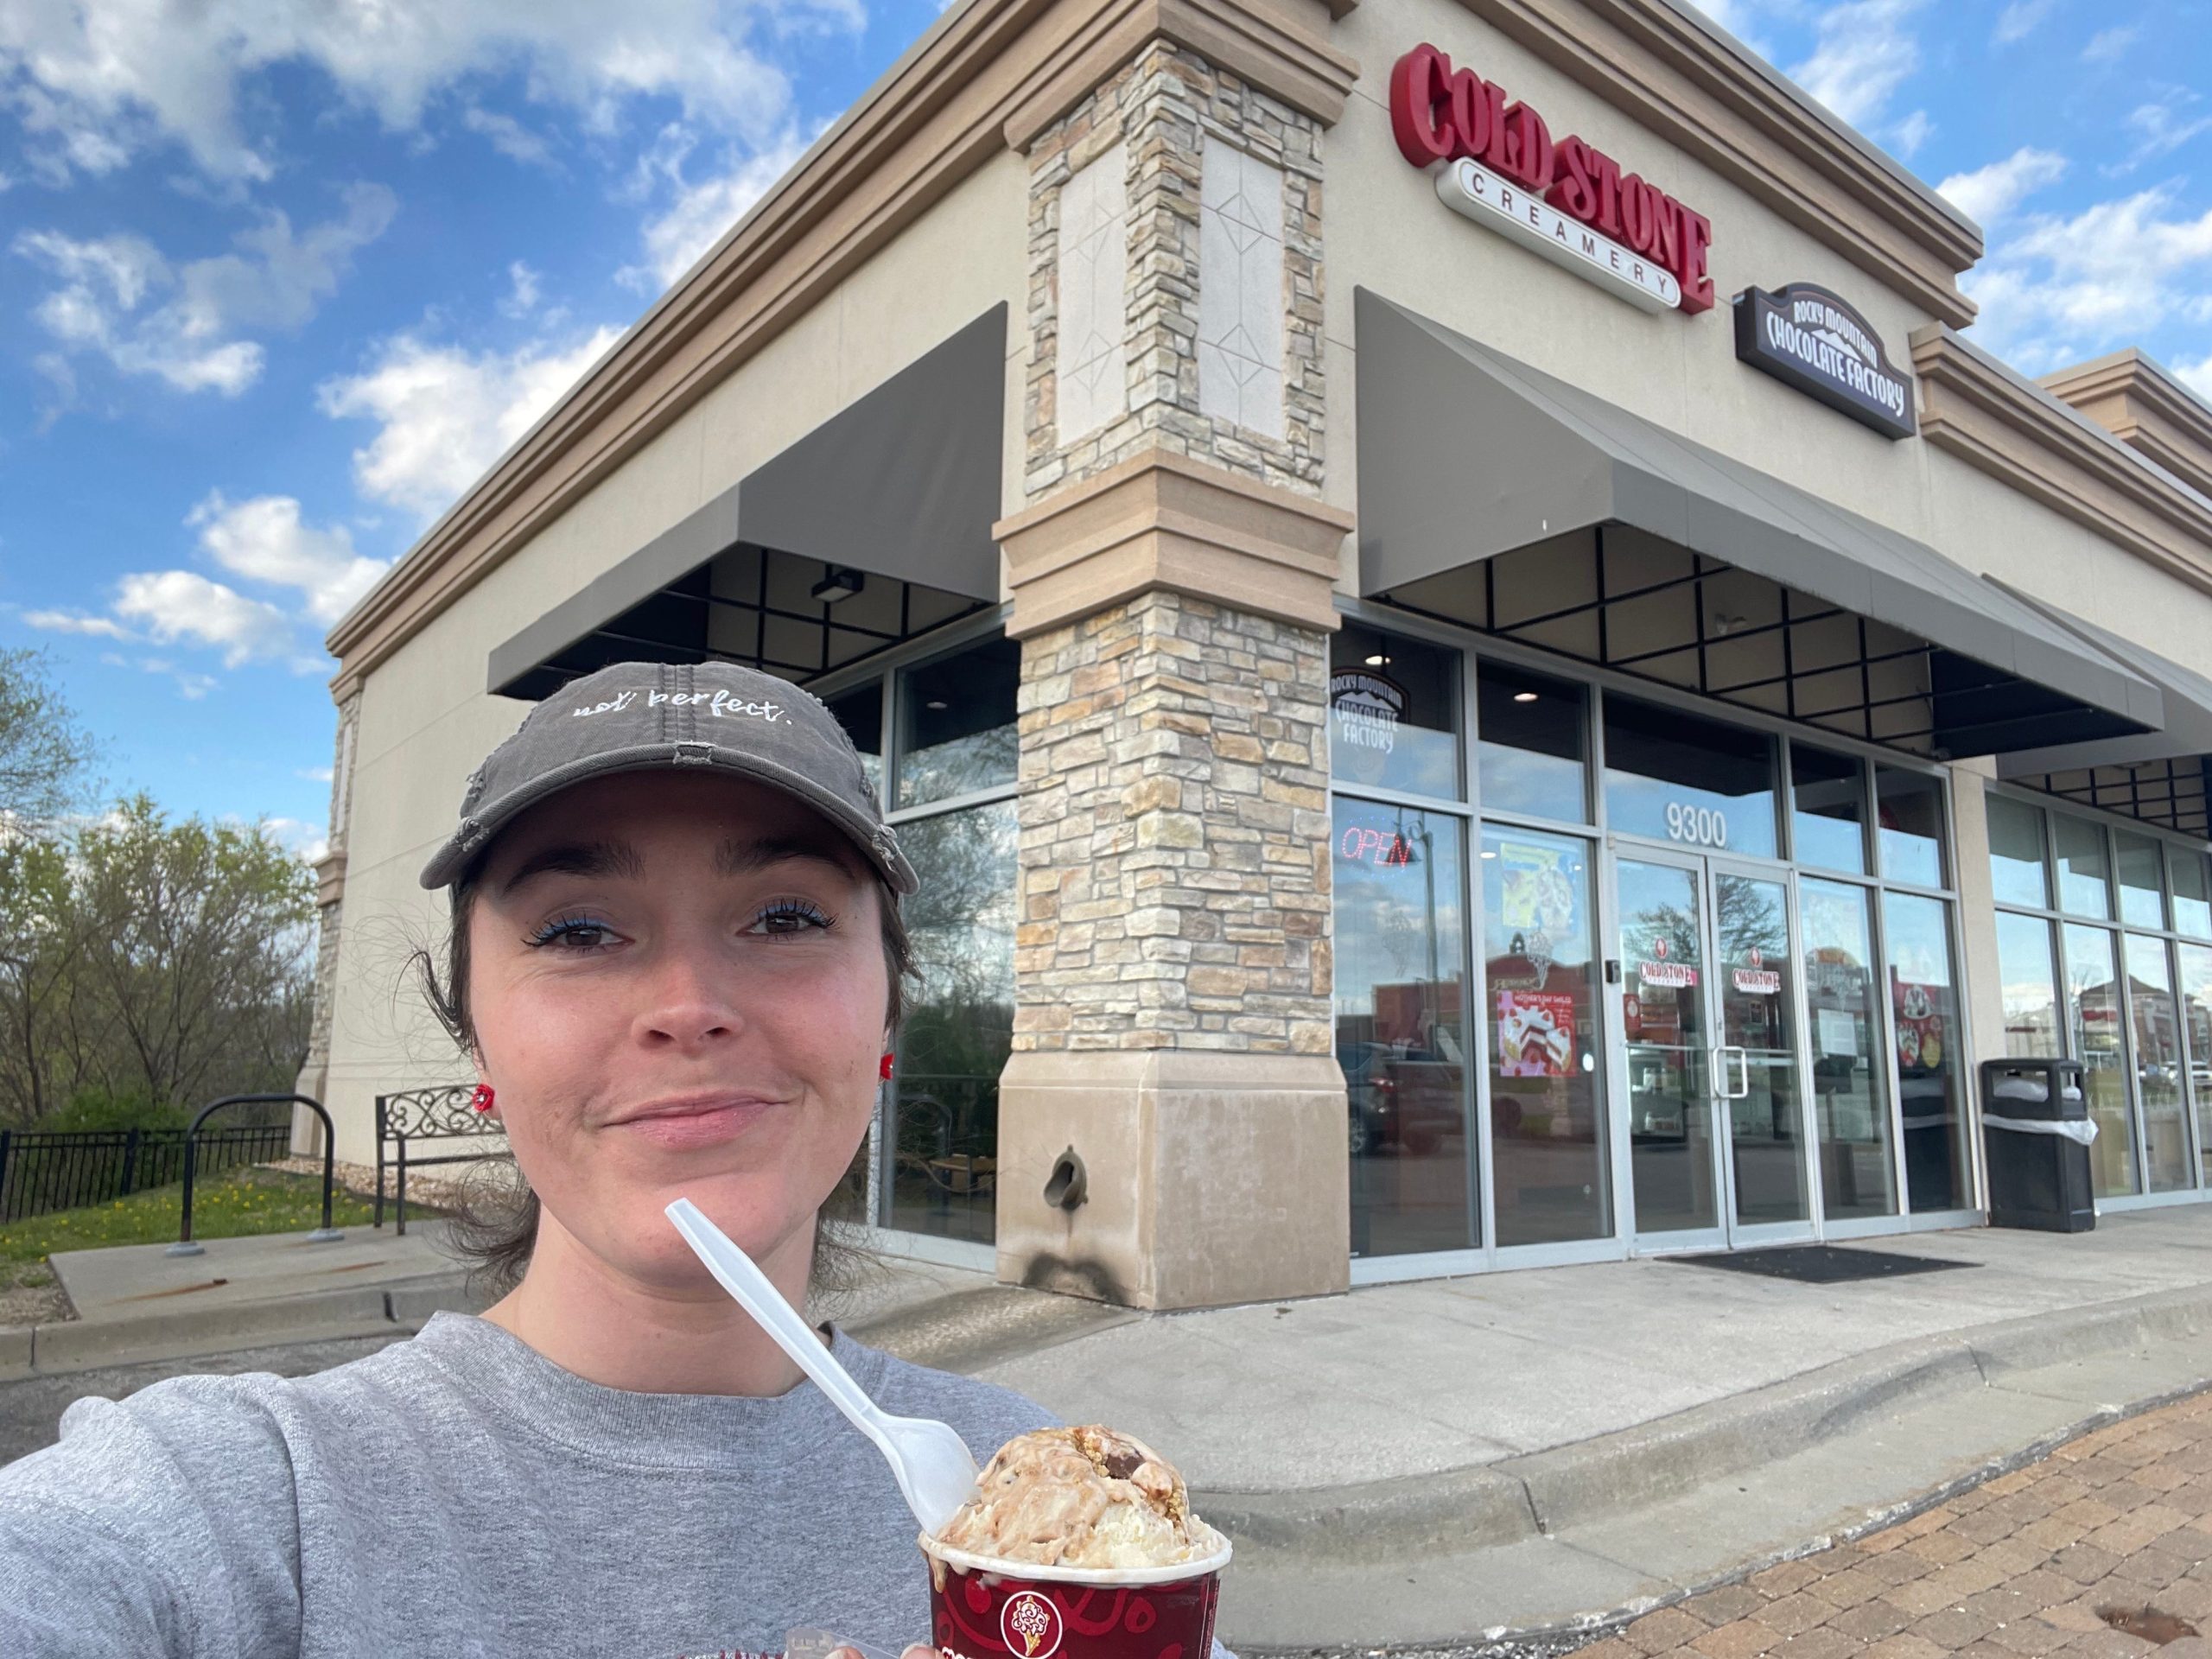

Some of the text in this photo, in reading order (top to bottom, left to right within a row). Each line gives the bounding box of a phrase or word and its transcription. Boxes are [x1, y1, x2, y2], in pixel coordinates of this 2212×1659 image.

[1389, 42, 1714, 315] COLD STONE
[1471, 173, 1669, 294] CREAMERY
[1793, 300, 1878, 370] ROCKY MOUNTAIN
[1766, 311, 1904, 417] CHOCOLATE FACTORY
[573, 690, 792, 725] not perfect.
[1331, 674, 1403, 709] ROCKY MOUNTAIN
[1335, 700, 1399, 733] CHOCOLATE
[1343, 722, 1394, 754] FACTORY
[1666, 801, 1726, 847] 9300
[1342, 827, 1413, 868] OPEN
[1640, 961, 1662, 979] COLD
[1663, 963, 1692, 982] STONE
